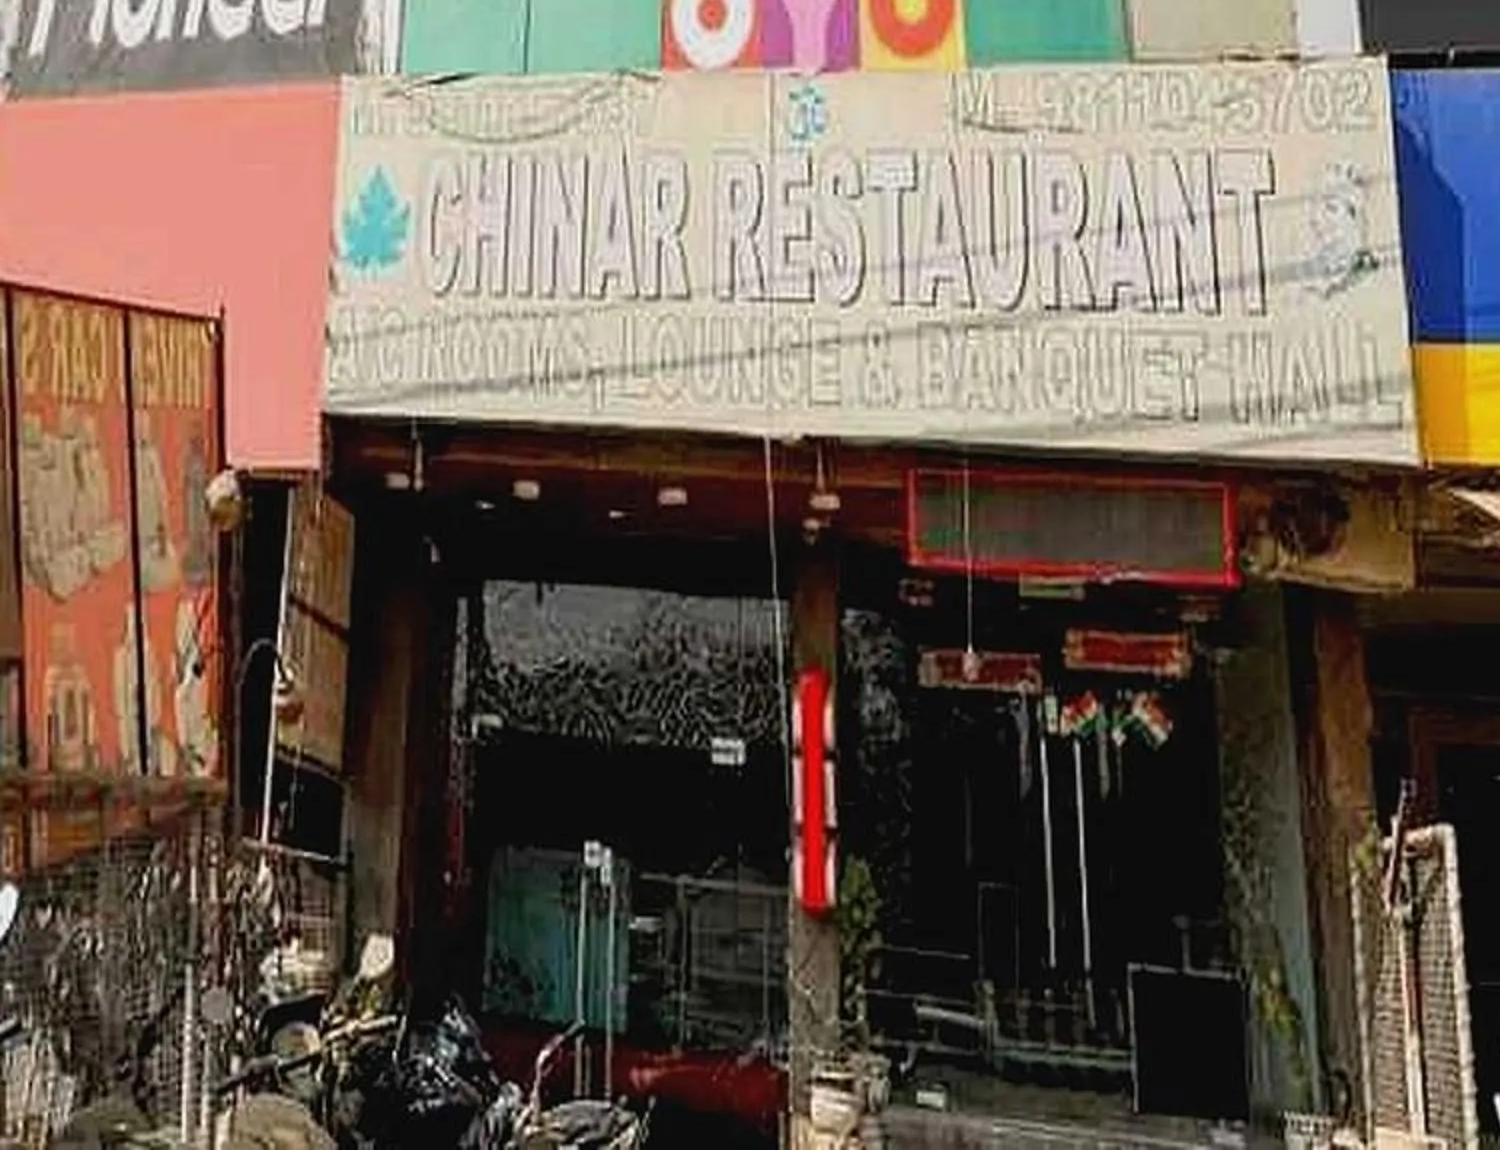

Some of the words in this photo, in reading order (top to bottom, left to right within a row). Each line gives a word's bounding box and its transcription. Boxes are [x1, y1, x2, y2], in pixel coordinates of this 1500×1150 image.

[428, 153, 691, 301] CHINAR
[711, 150, 1277, 317] RESTAURANT
[621, 315, 842, 408] LOUNGE
[917, 323, 1208, 423] BANQUET
[1227, 322, 1404, 430] HALL
